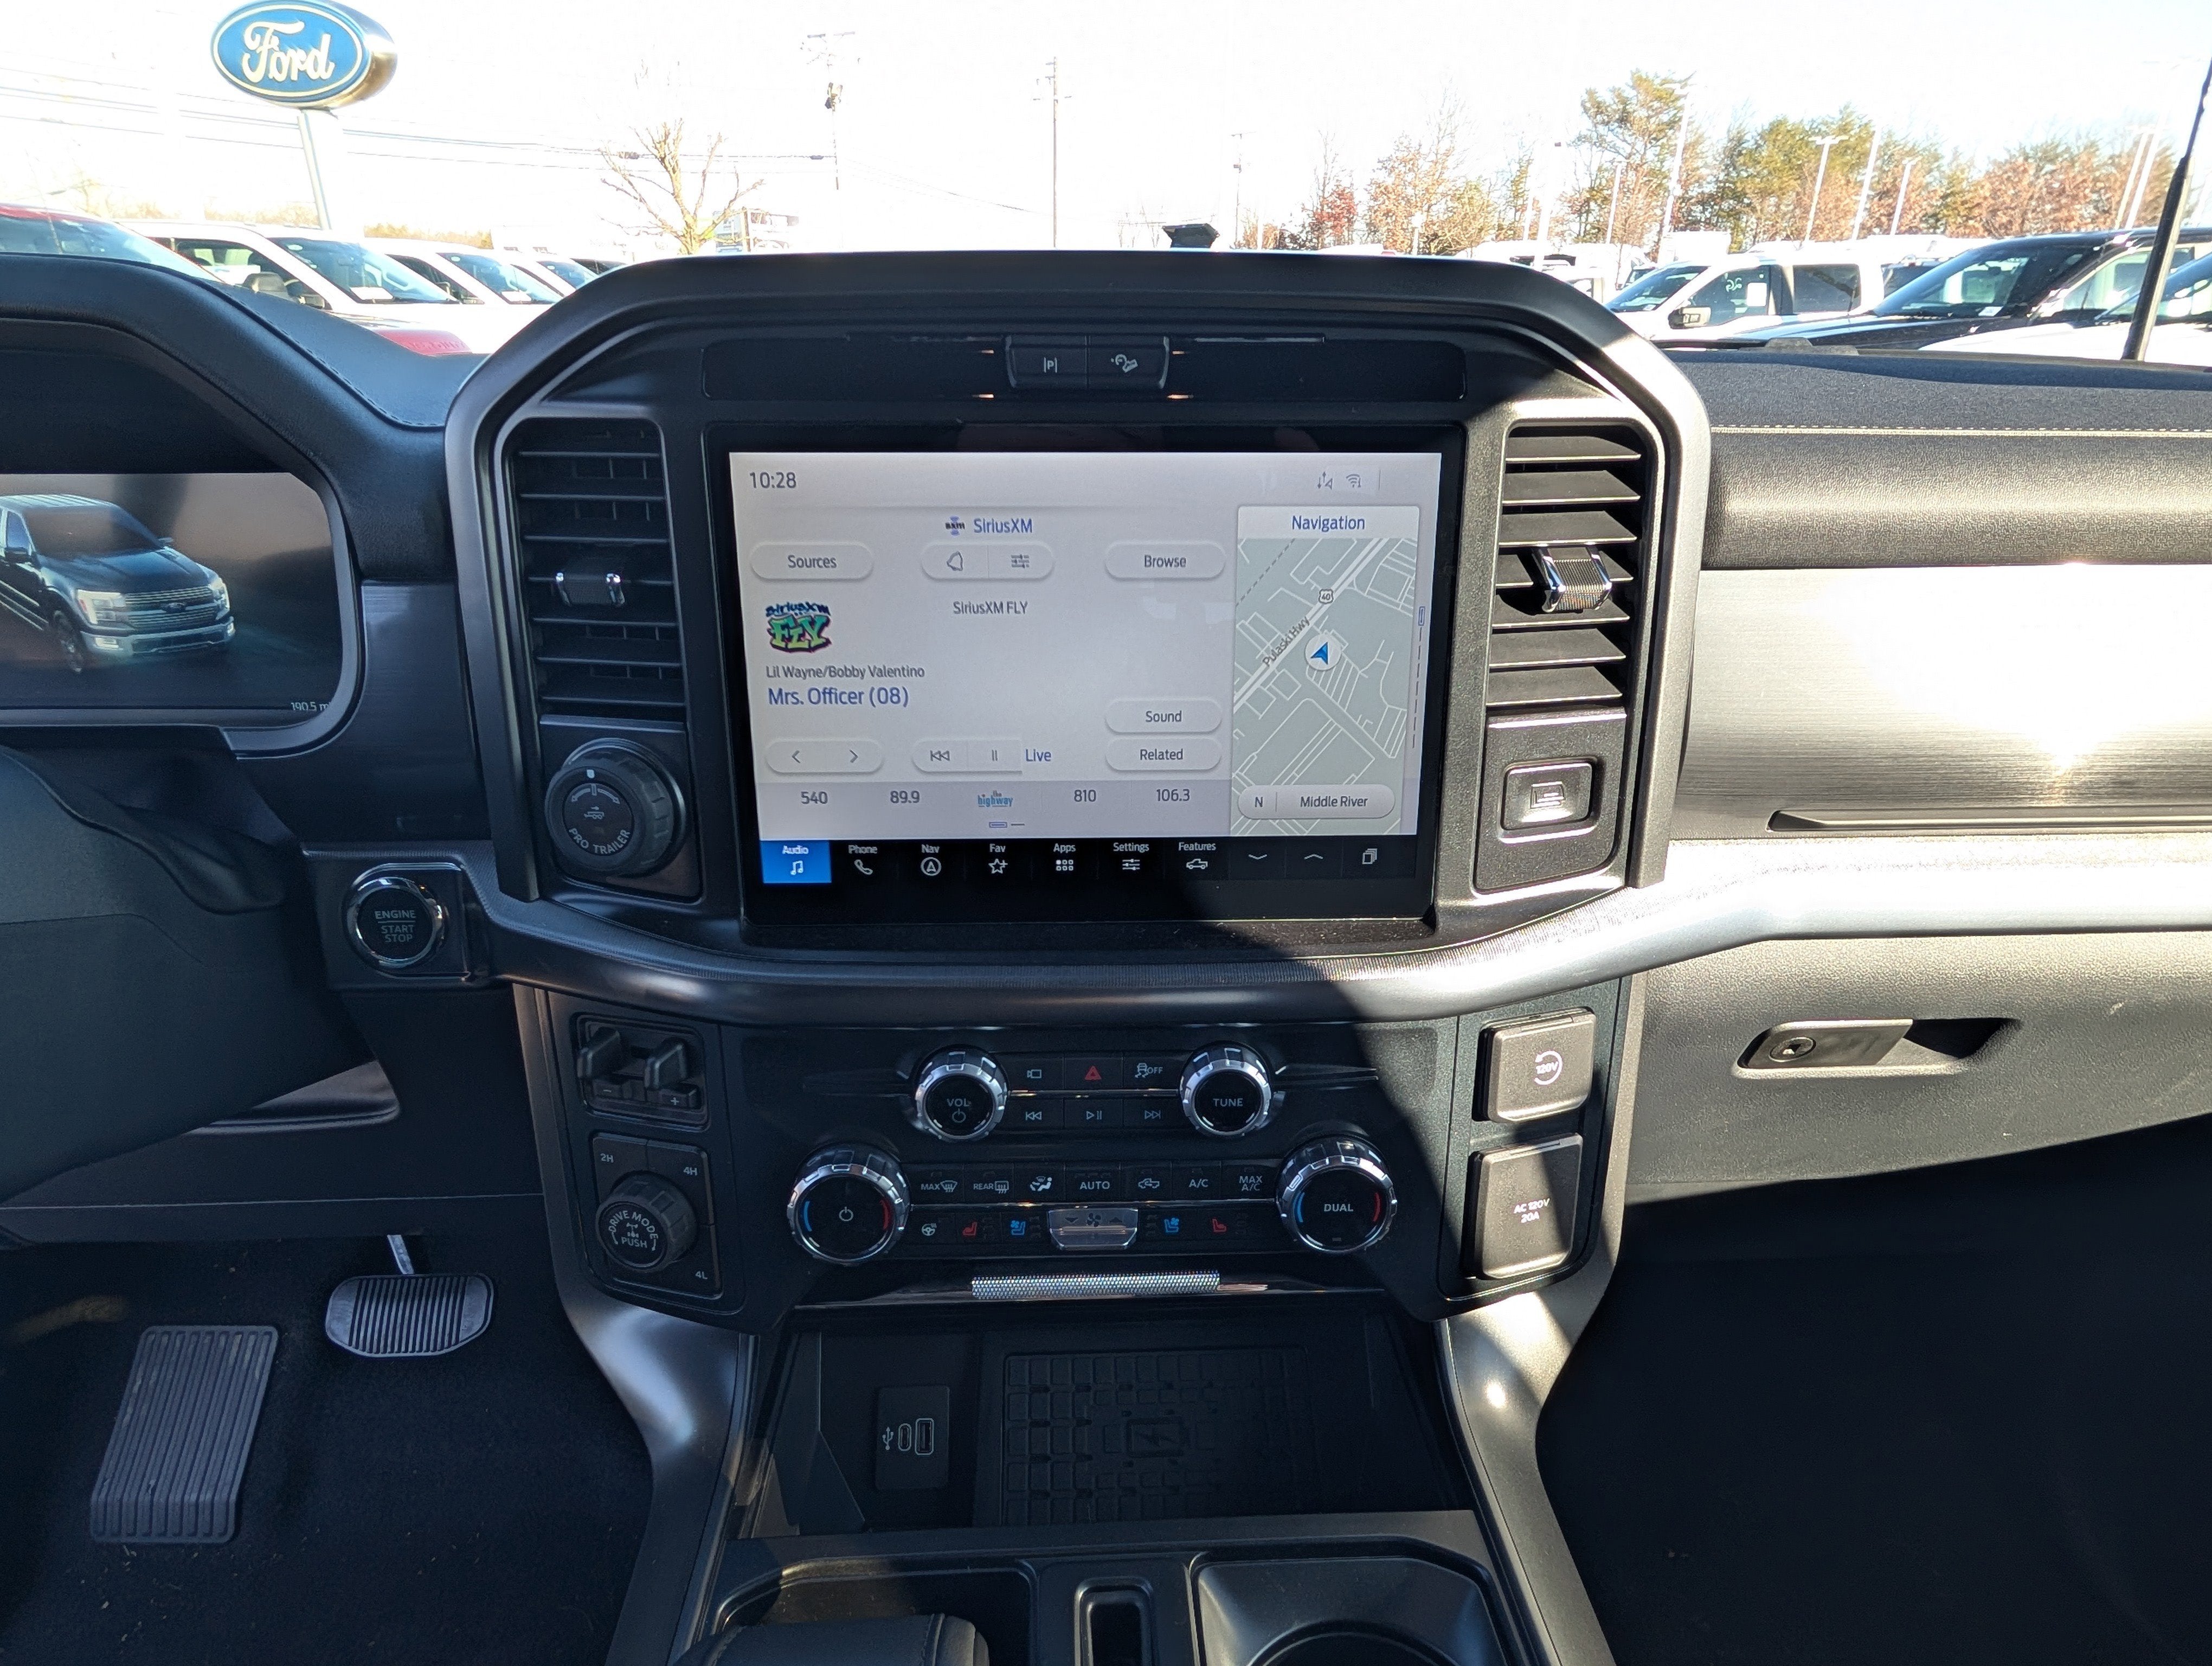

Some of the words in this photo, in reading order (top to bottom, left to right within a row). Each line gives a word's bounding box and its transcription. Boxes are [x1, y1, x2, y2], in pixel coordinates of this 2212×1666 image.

[242, 20, 336, 83] Ford
[749, 471, 797, 489] 10:28
[973, 517, 1033, 534] SiriusXM
[1291, 515, 1366, 533] Navigation
[787, 554, 838, 569] Sources
[1143, 554, 1187, 568] Browse
[1321, 593, 1331, 601] 40
[953, 601, 1004, 615] SiriusXM
[1006, 601, 1028, 614] FLY
[767, 613, 832, 653] FLY
[1262, 633, 1294, 667] Pulaski
[1289, 616, 1310, 638] Hwy
[766, 665, 780, 678] Lil
[783, 665, 866, 681] Wayne/Bobby
[868, 665, 925, 678] Valentino
[768, 688, 804, 706] Mrs.
[808, 687, 865, 705] Officer
[869, 686, 909, 708] (08)
[319, 703, 330, 712] m
[1145, 710, 1182, 723] Sound
[1025, 748, 1052, 762] Live
[1140, 748, 1184, 761] Related
[800, 791, 828, 805] 540
[890, 790, 921, 804] 89.9
[978, 793, 1013, 808] highway
[1073, 789, 1097, 803] 810
[1156, 789, 1191, 802] 106.3
[1254, 796, 1263, 808] N
[1300, 795, 1338, 808] Middle
[1340, 795, 1368, 807] River
[569, 828, 589, 849] PRO
[593, 829, 631, 855] TRAILER
[1113, 842, 1149, 853] Settings
[1179, 842, 1216, 851] Features
[782, 845, 809, 855] Audio
[848, 844, 878, 854] Phone
[922, 844, 940, 854] Nav
[989, 843, 1006, 854] Fav
[1053, 843, 1076, 855] Apps
[375, 909, 416, 919] ENGINE
[381, 924, 414, 934] START
[385, 933, 413, 943] STOP
[1147, 1066, 1163, 1074] OFF
[1535, 1061, 1559, 1074] 120V
[947, 1098, 969, 1107] VOL
[1213, 1098, 1243, 1107] TUNE
[600, 1152, 614, 1163] 2H
[683, 1166, 698, 1176] 4H
[1079, 1181, 1111, 1190] AUTO
[1188, 1178, 1209, 1188] A/C
[1239, 1175, 1263, 1184] MAX
[1241, 1183, 1261, 1191] A/C
[1324, 1203, 1354, 1212] DUAL
[1513, 1203, 1527, 1214] AC
[1528, 1198, 1550, 1210] 120V
[1521, 1212, 1540, 1223] 20A
[608, 1210, 630, 1233] DRIVE
[631, 1212, 659, 1240] MODE
[621, 1236, 648, 1248] PUSH
[695, 1270, 708, 1280] 4L
